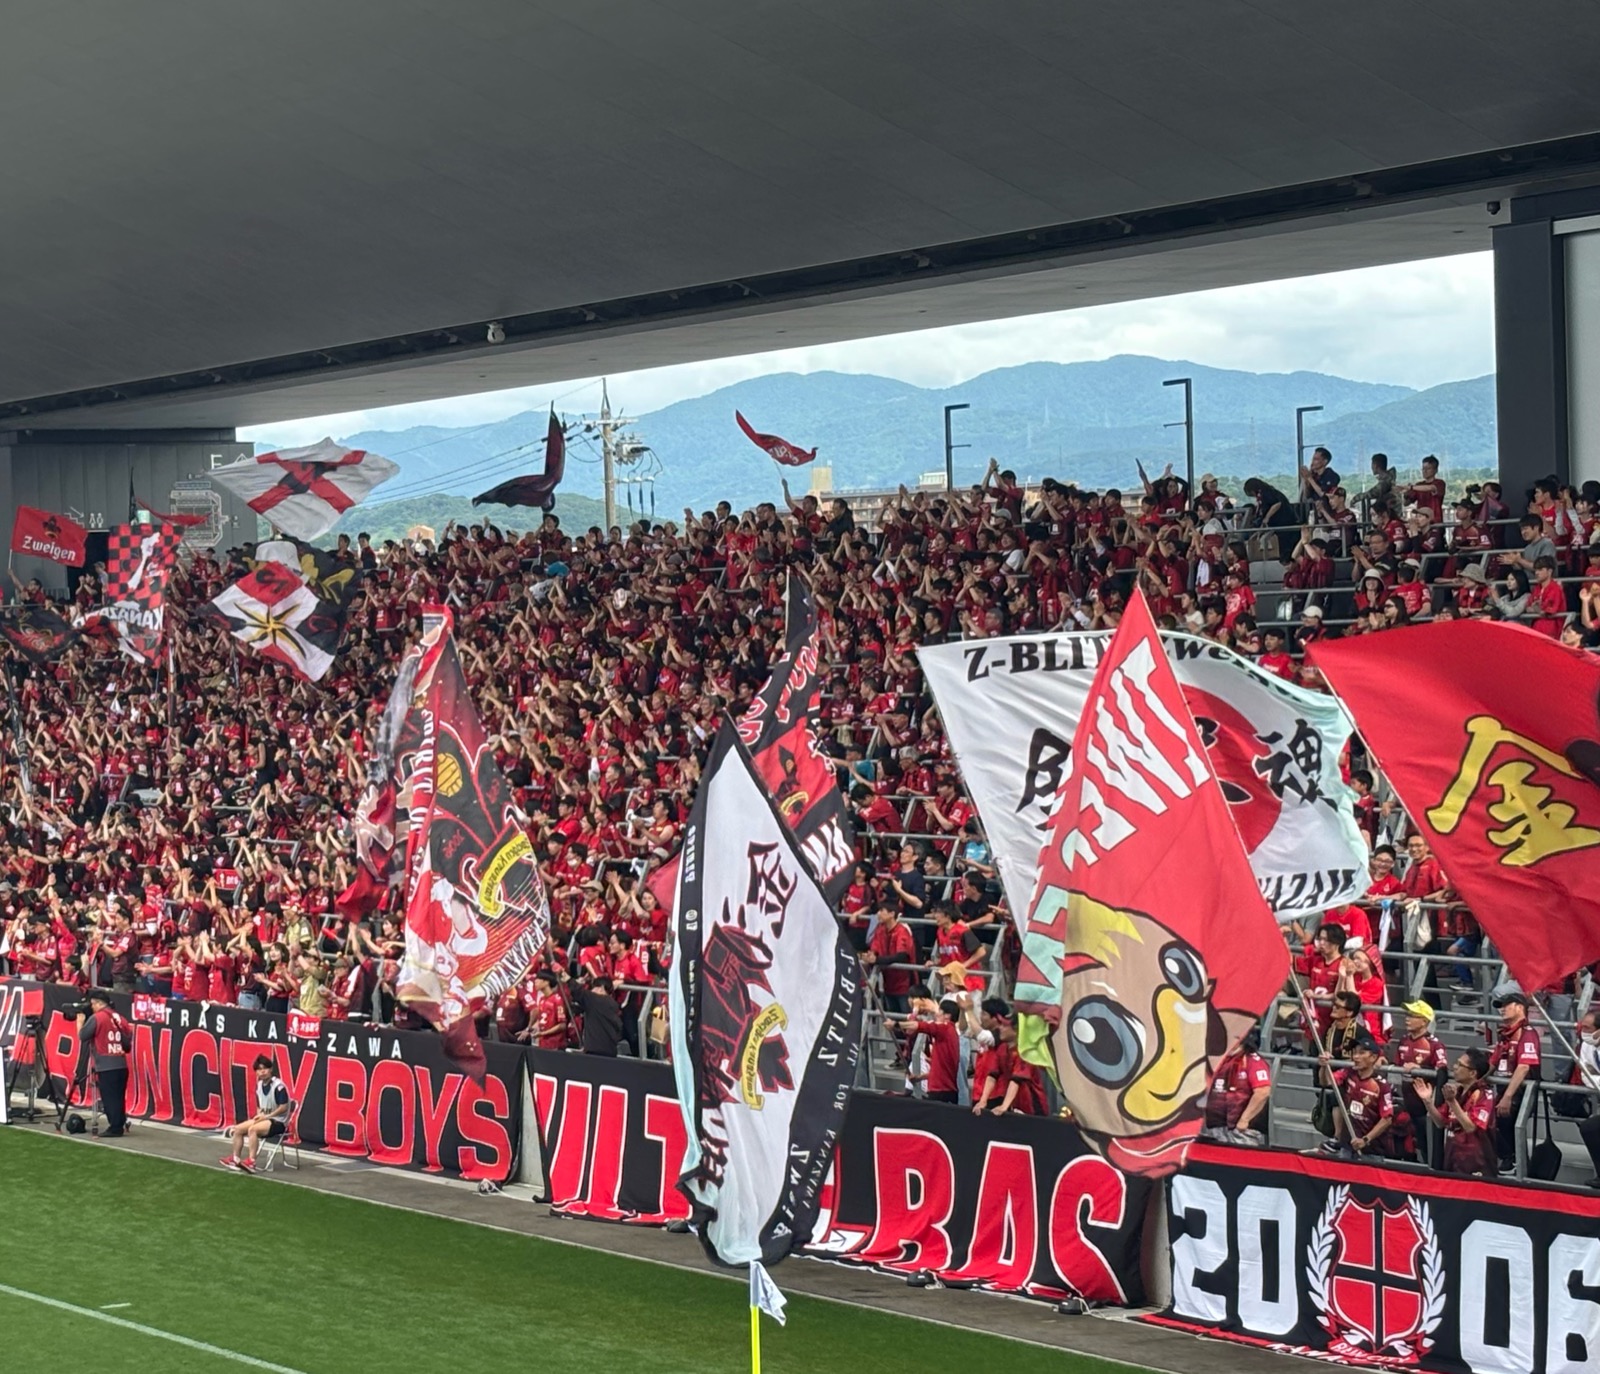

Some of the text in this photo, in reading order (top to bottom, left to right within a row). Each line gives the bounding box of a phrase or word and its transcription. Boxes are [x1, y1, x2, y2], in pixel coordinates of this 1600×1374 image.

[21, 534, 77, 561] Zweigen
[963, 635, 1112, 683] Z-BLIT
[249, 1019, 402, 1059] KAZAWA
[321, 1055, 513, 1182] BOYS
[1171, 1174, 1299, 1336] 20
